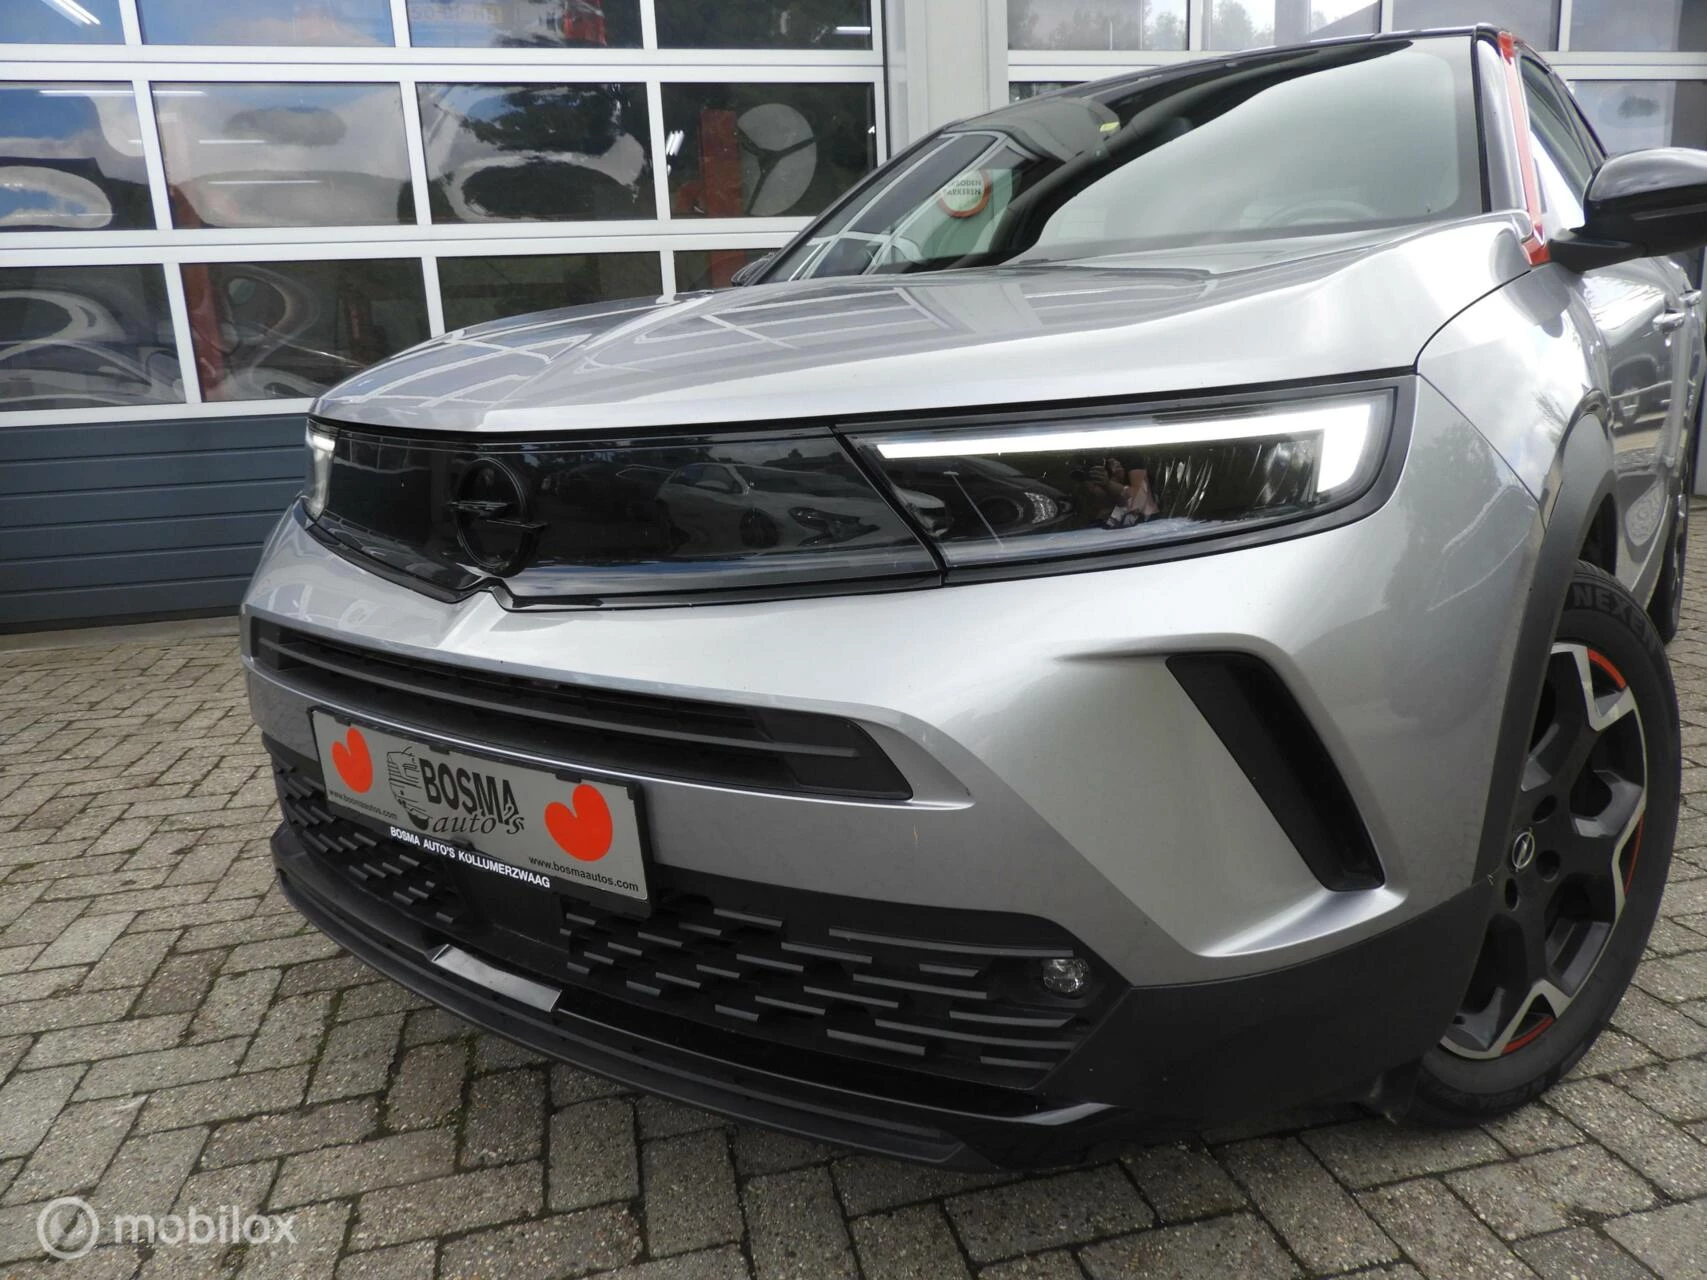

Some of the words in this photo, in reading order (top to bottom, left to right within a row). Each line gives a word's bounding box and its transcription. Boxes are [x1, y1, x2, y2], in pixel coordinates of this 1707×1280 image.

[1572, 584, 1660, 653] NEXEN
[419, 758, 520, 825] BOSMA
[432, 804, 525, 835] auto's
[390, 826, 421, 846] BOSMA
[423, 839, 455, 859] AUTO'S
[458, 850, 551, 888] KOLLUMERZWAAG
[528, 856, 639, 892] www.bosmaautos.com
